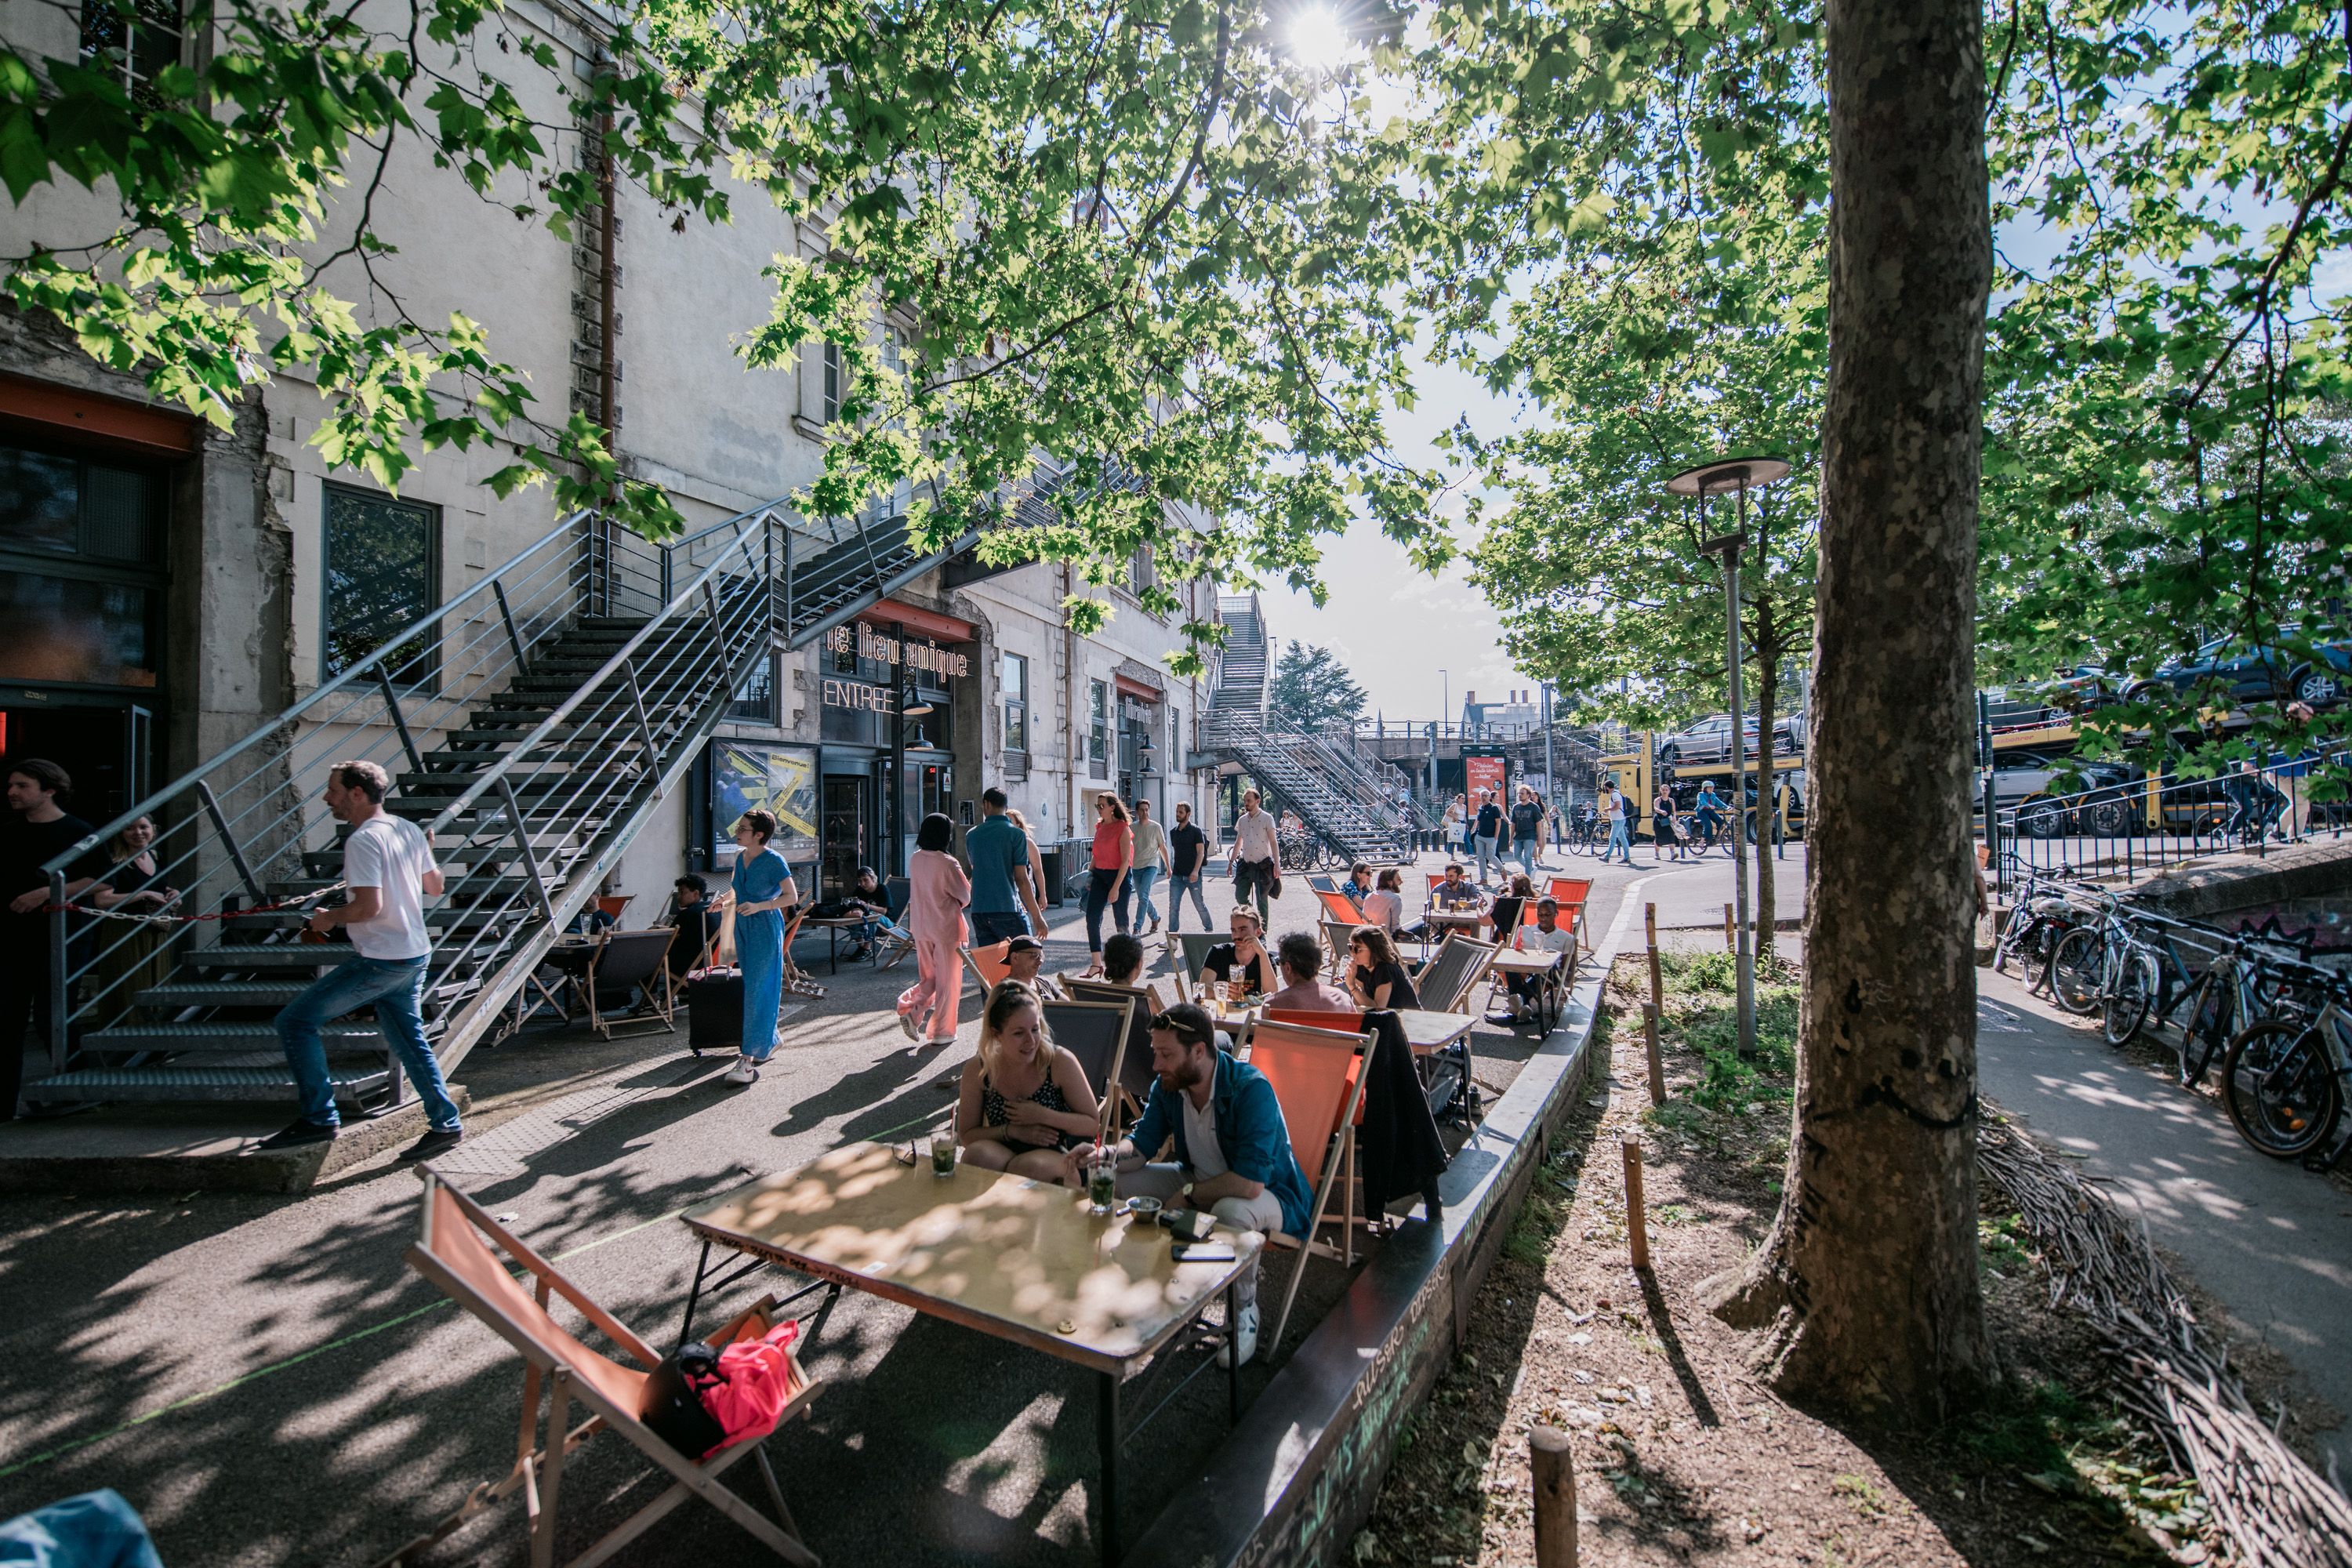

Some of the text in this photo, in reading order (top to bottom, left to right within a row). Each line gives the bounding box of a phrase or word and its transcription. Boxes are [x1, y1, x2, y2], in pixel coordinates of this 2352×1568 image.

[827, 621, 967, 683] le lieu unique
[824, 680, 898, 715] ENTREE
[1515, 771, 1523, 780] Z
